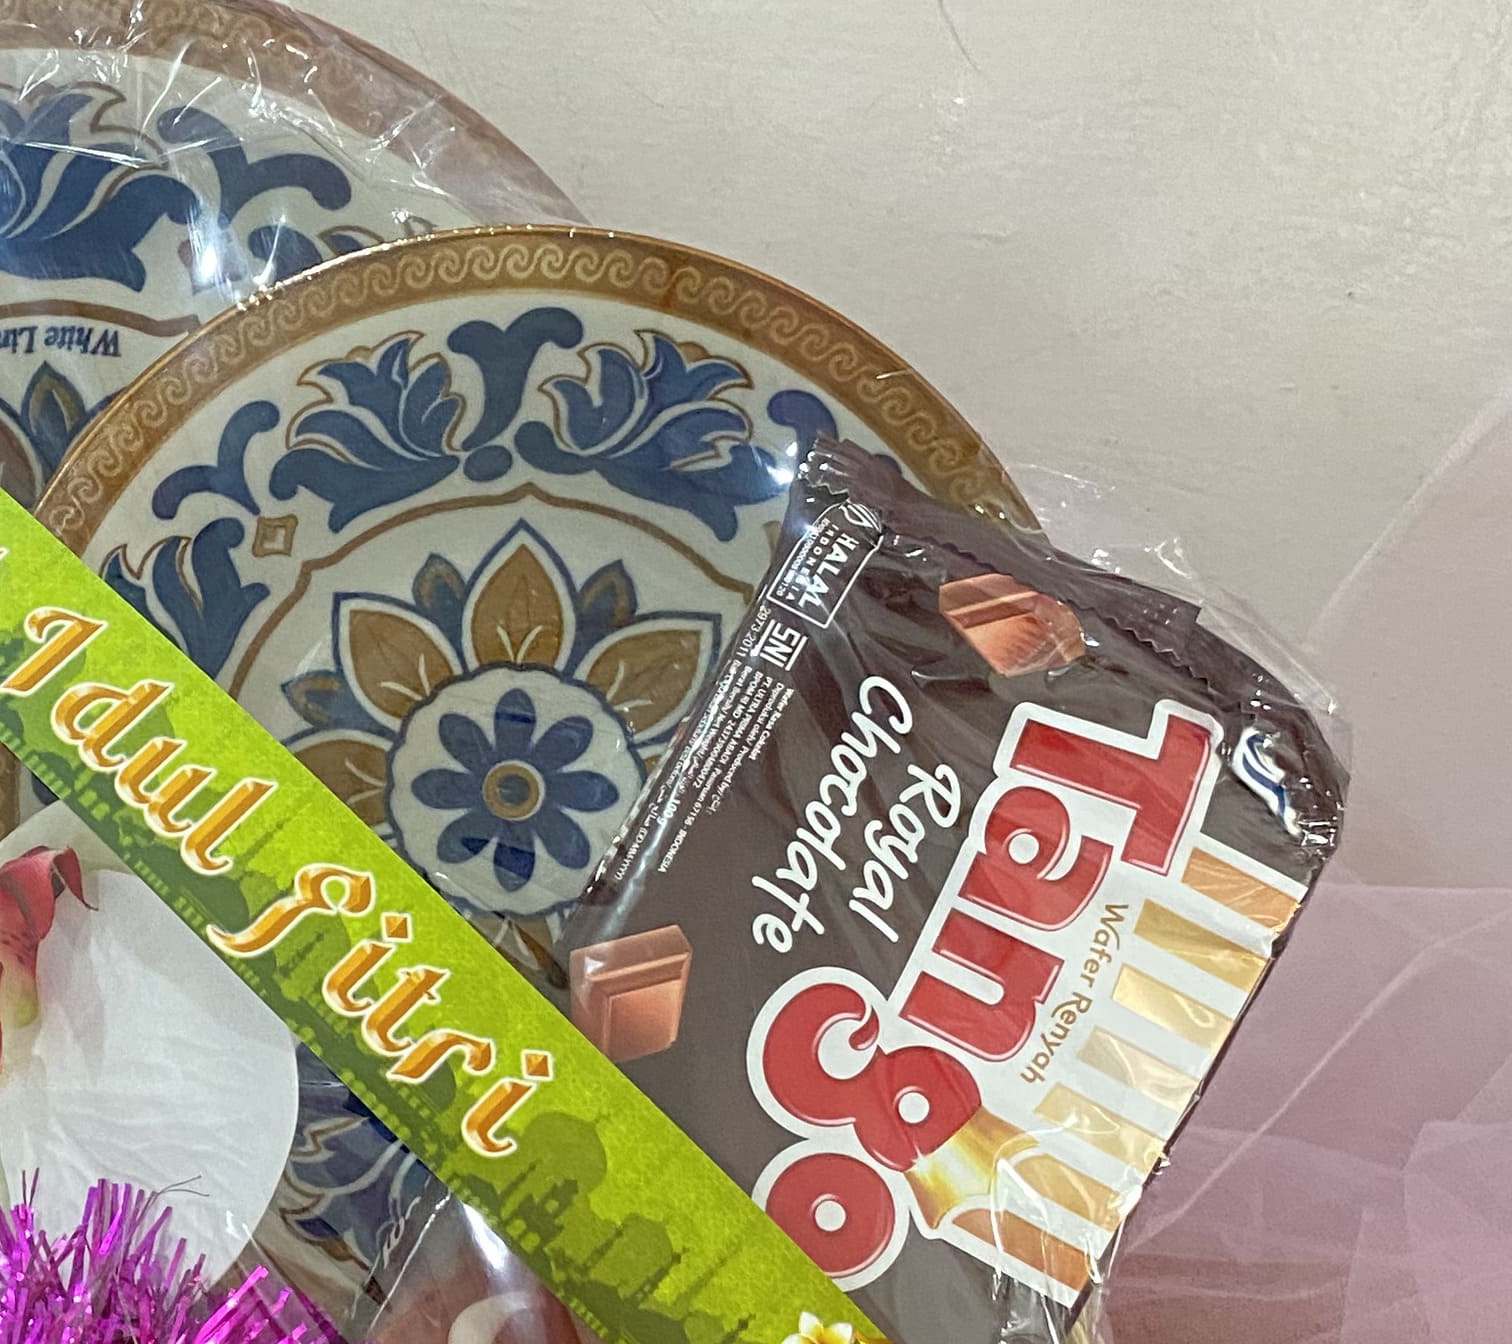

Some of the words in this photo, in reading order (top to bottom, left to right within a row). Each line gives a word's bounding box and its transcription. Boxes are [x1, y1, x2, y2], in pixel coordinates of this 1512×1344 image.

[44, 325, 121, 357] White
[797, 529, 859, 617] HALAL
[759, 621, 801, 669] SNI
[743, 670, 763, 696] BPOM
[746, 687, 766, 714] ULTRA
[731, 703, 744, 719] MD
[732, 712, 752, 739] PRIMA
[718, 737, 737, 764] ABADI
[724, 744, 749, 782] Produced
[696, 766, 720, 802] Pasuruan
[751, 675, 913, 954] Chocolate
[656, 828, 687, 874] INDONESIA
[849, 762, 962, 944] Royal
[1080, 903, 1129, 993] Wafer
[206, 862, 554, 1157] Fitri
[755, 706, 1217, 1284] Tango
[1020, 990, 1092, 1086] Renyah
